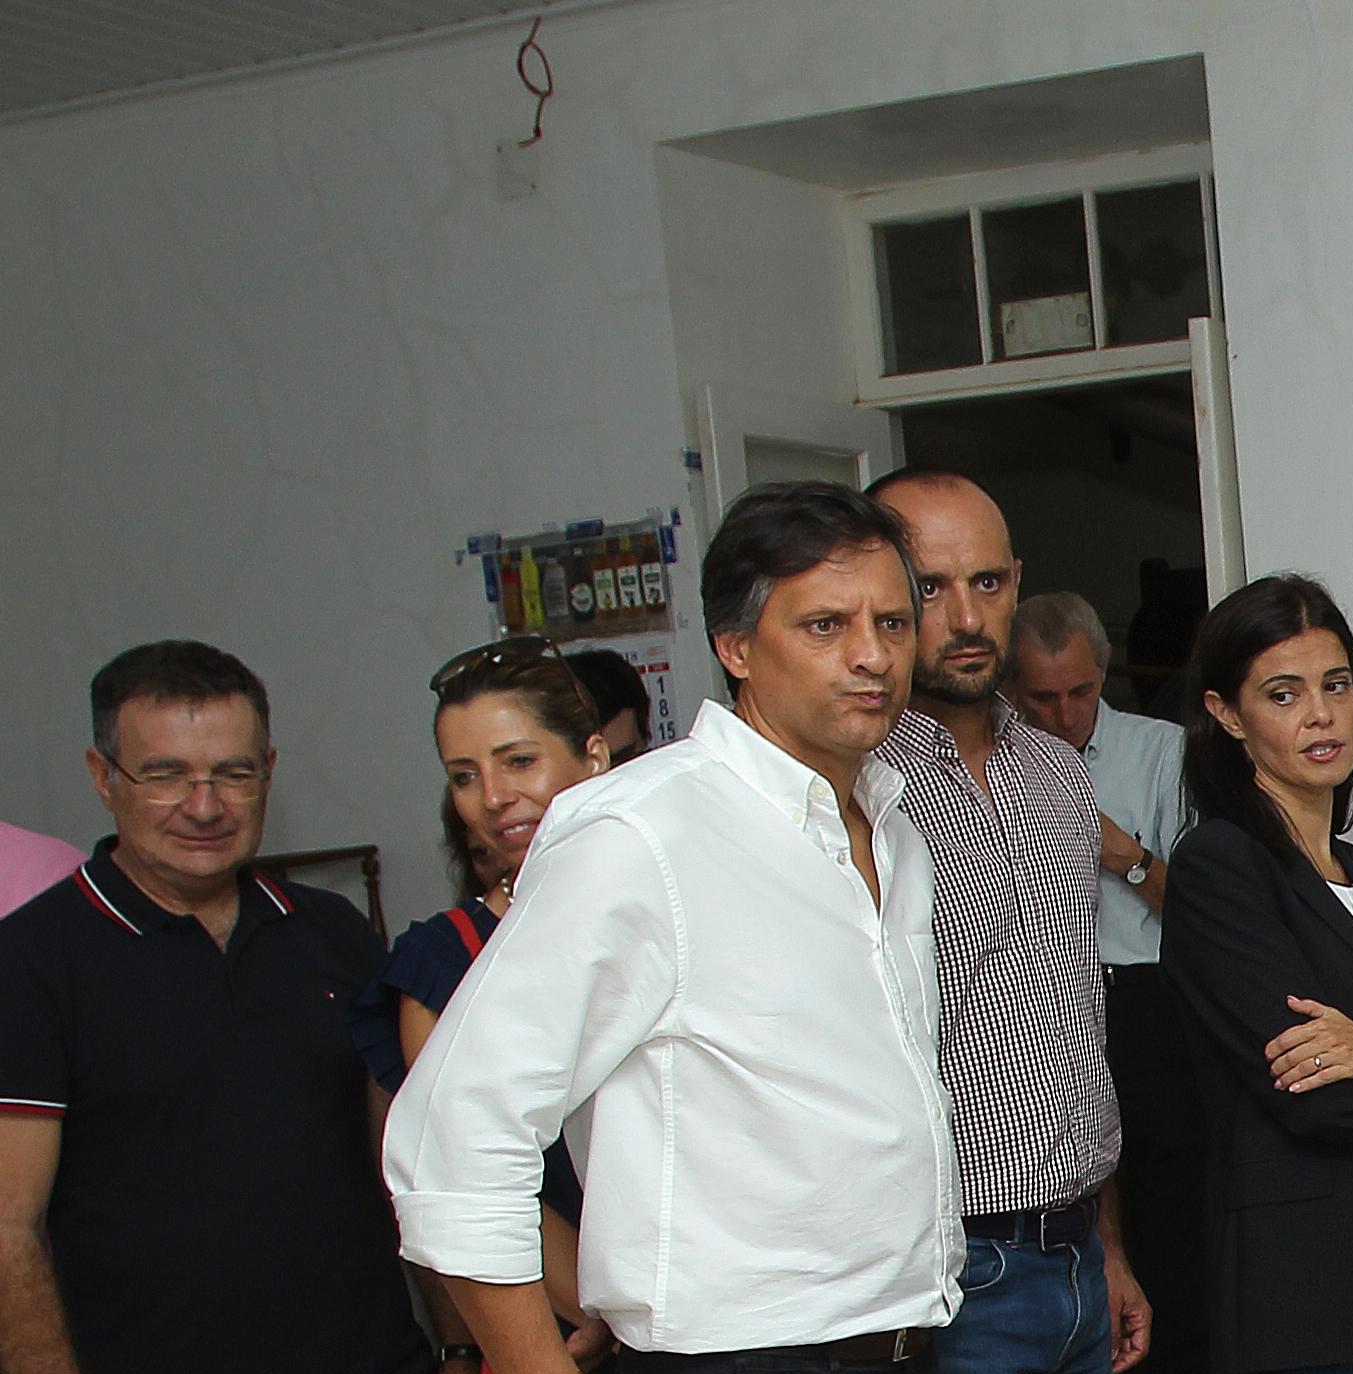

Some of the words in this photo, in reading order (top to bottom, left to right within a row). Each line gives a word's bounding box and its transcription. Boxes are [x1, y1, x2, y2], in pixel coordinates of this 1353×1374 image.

[656, 675, 665, 694] 1
[659, 698, 670, 718] 8
[658, 721, 676, 741] 15
